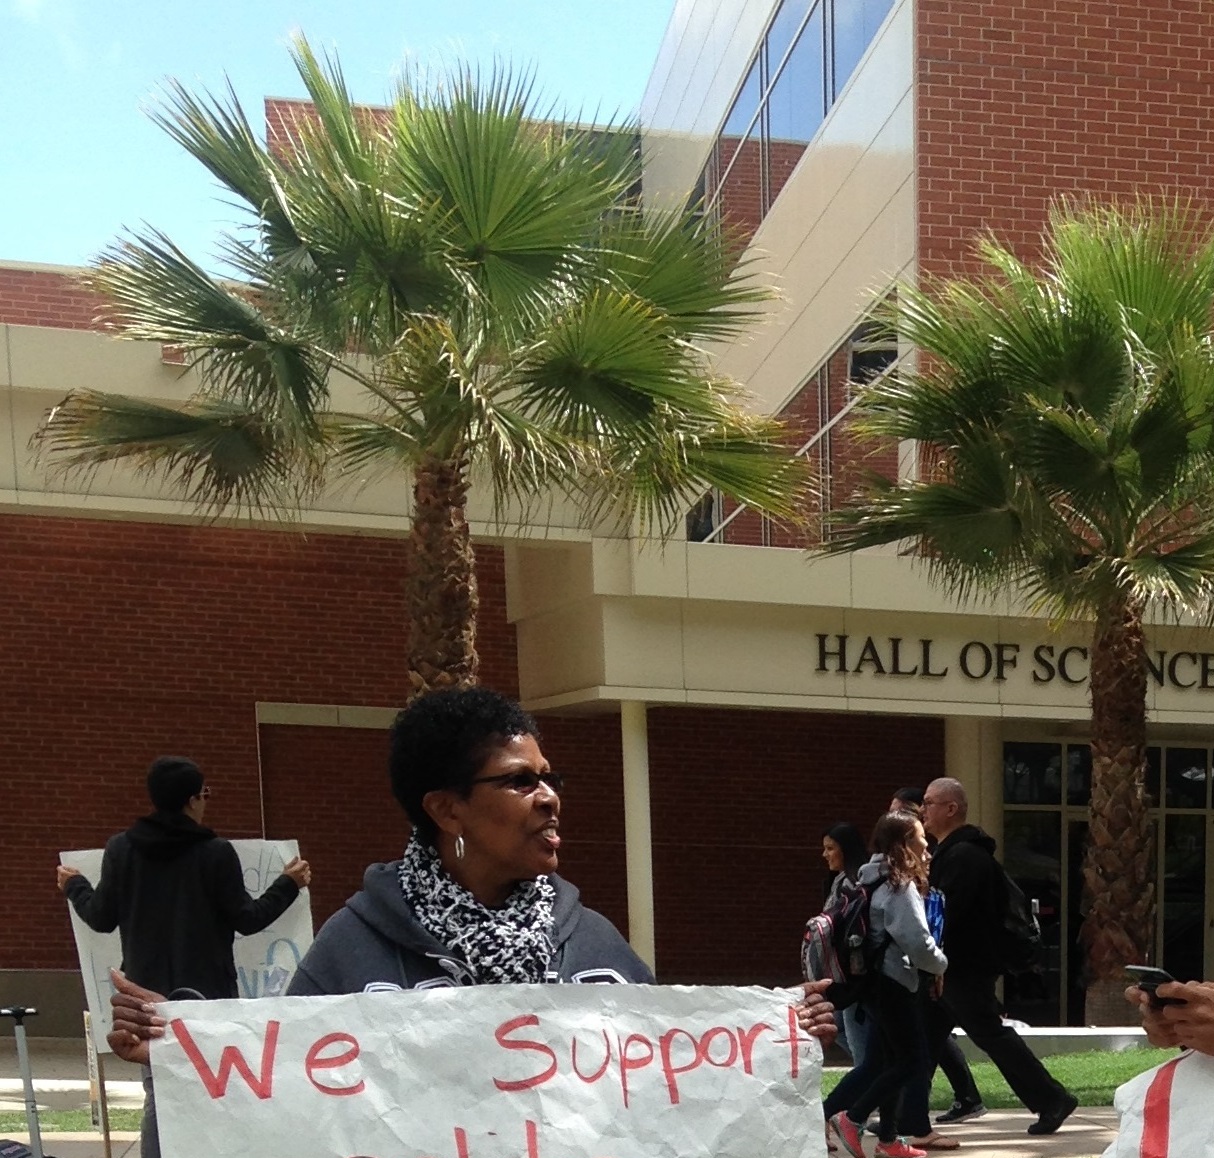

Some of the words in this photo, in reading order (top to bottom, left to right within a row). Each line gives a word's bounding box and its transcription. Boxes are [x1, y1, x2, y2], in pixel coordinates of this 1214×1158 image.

[815, 633, 948, 678] HALL
[959, 640, 1020, 682] OF
[170, 1018, 366, 1101] We
